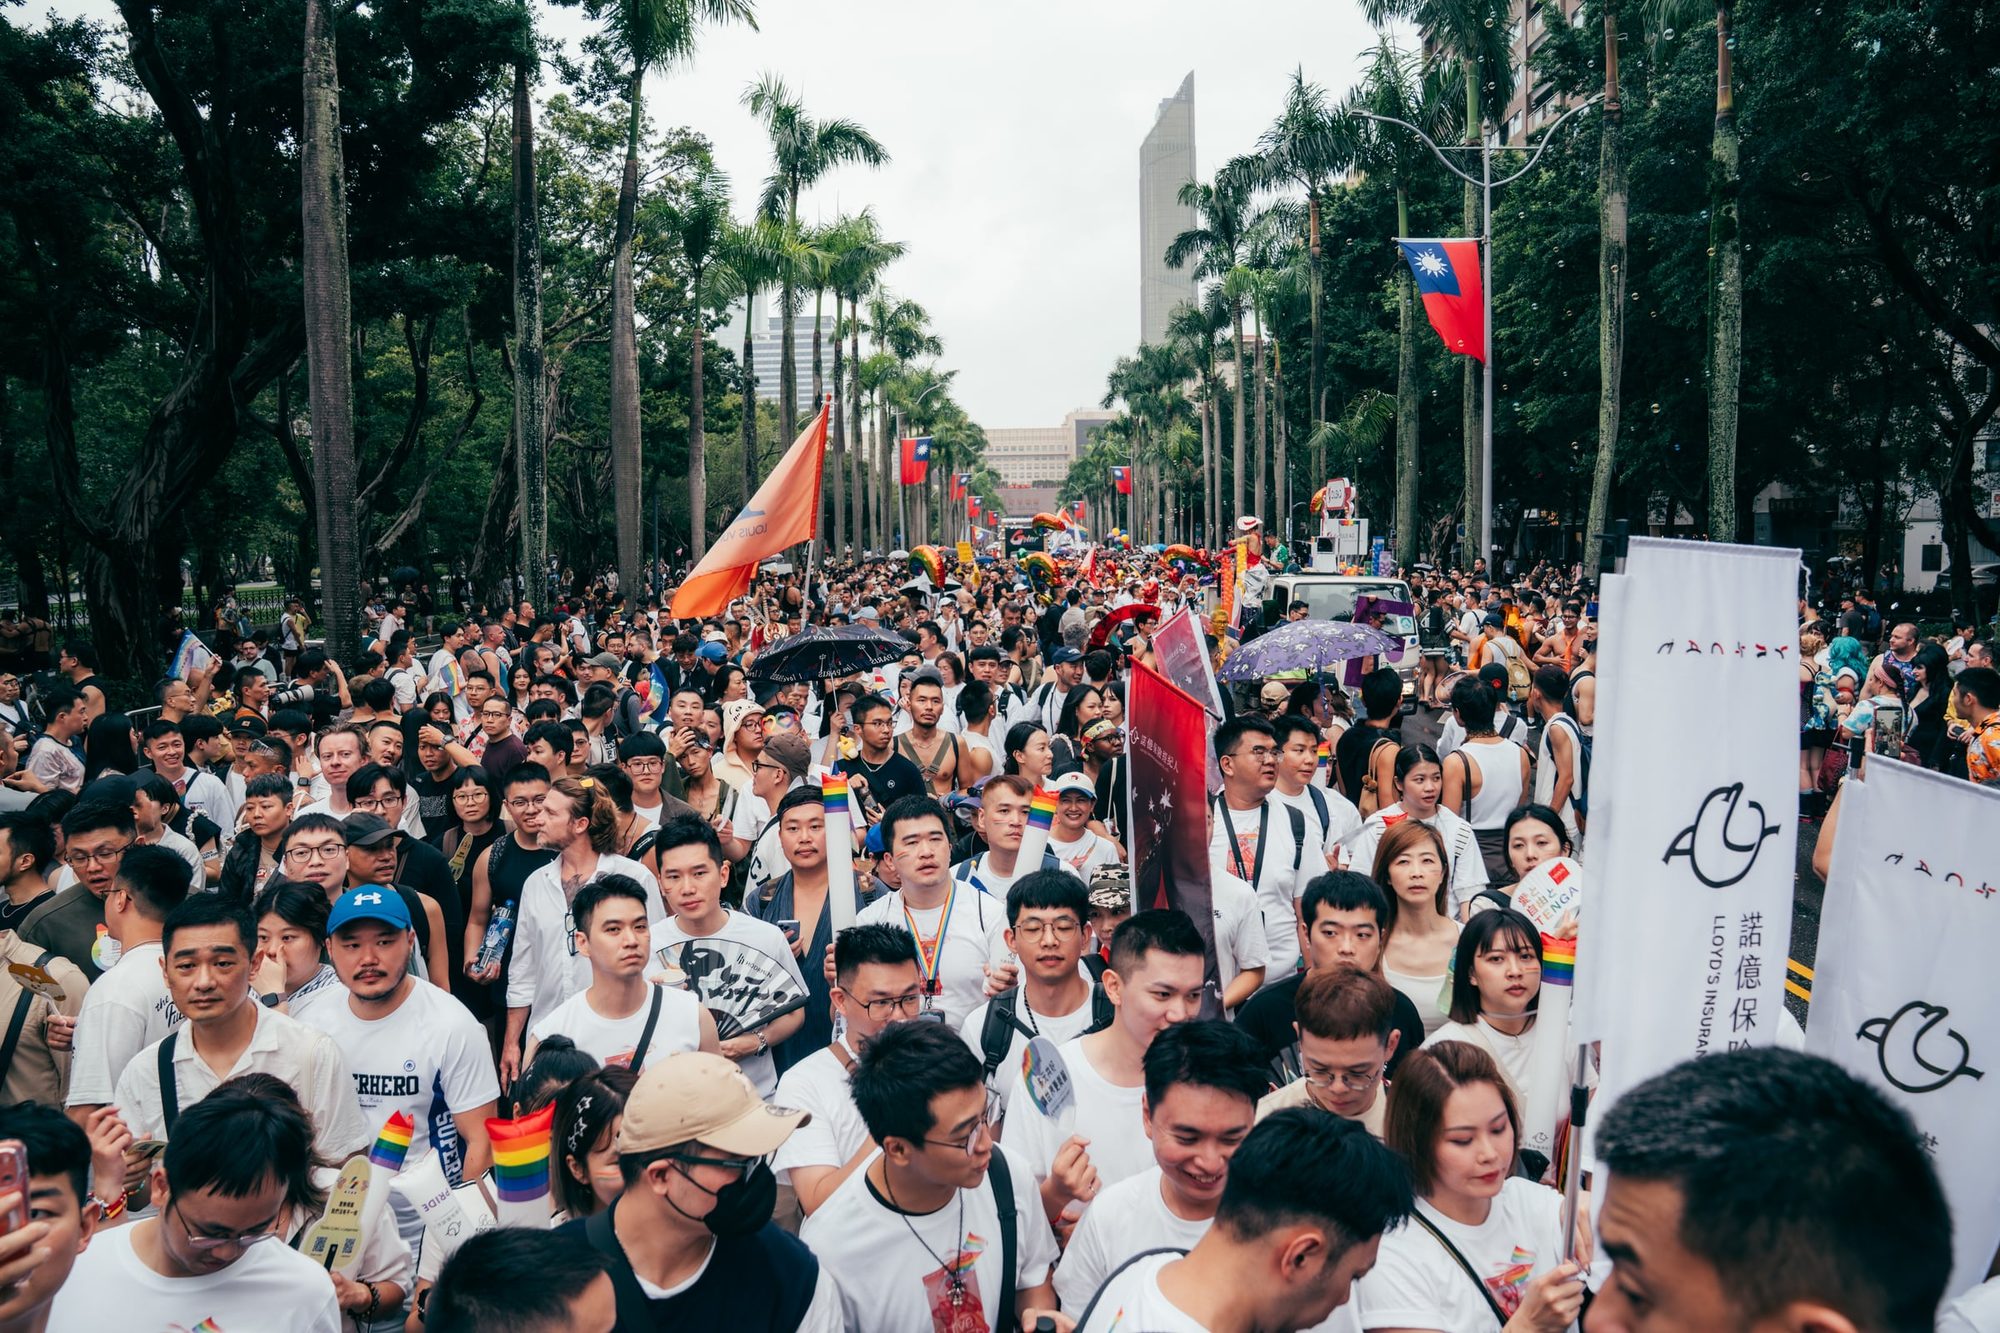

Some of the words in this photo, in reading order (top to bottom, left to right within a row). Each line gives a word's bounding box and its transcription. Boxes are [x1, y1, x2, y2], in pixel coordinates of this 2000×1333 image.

[1535, 886, 1579, 925] TENGA
[1707, 915, 1726, 985] LLOYD'S
[421, 1188, 451, 1213] PRIDE
